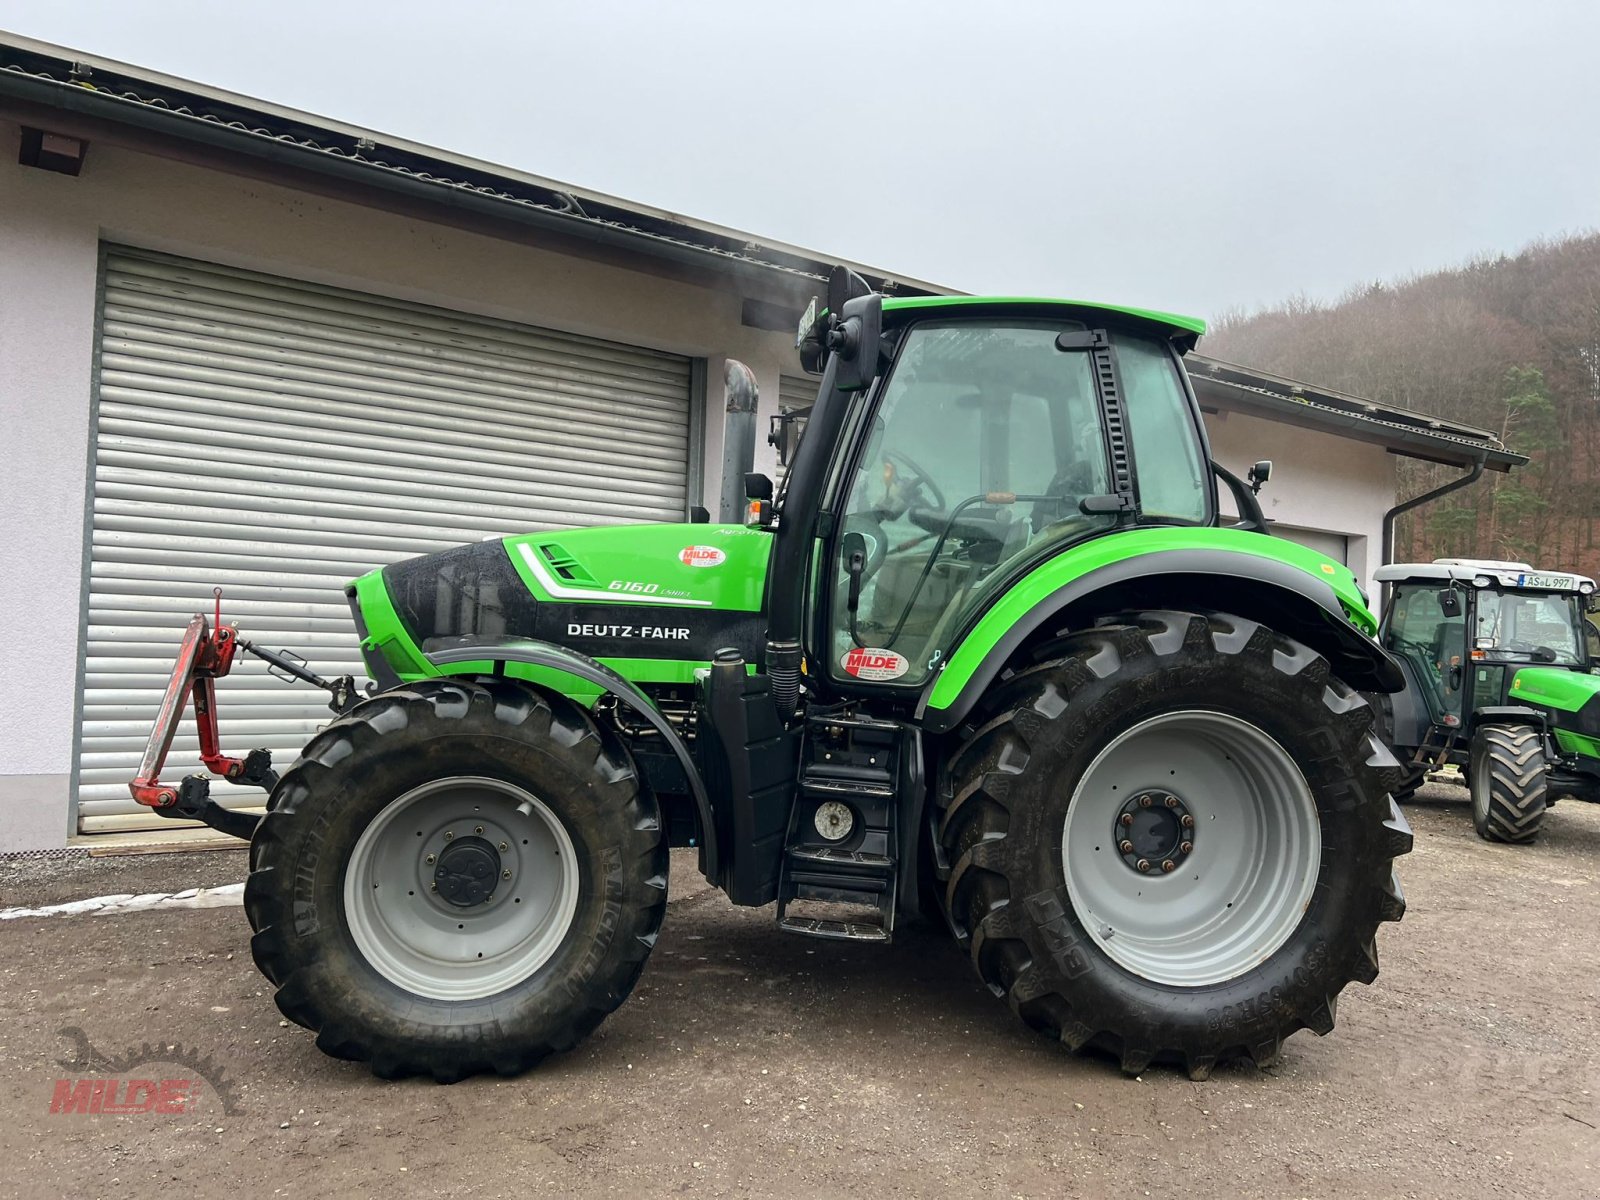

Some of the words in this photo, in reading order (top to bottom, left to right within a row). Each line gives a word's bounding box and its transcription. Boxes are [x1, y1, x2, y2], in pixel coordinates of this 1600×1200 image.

[683, 550, 718, 559] MILDE
[607, 579, 660, 594] 6160
[1527, 576, 1540, 587] AS
[1545, 578, 1551, 587] L
[1553, 578, 1569, 588] 997
[567, 623, 691, 641] DEUTZ-FAHR
[847, 654, 898, 669] MILDE
